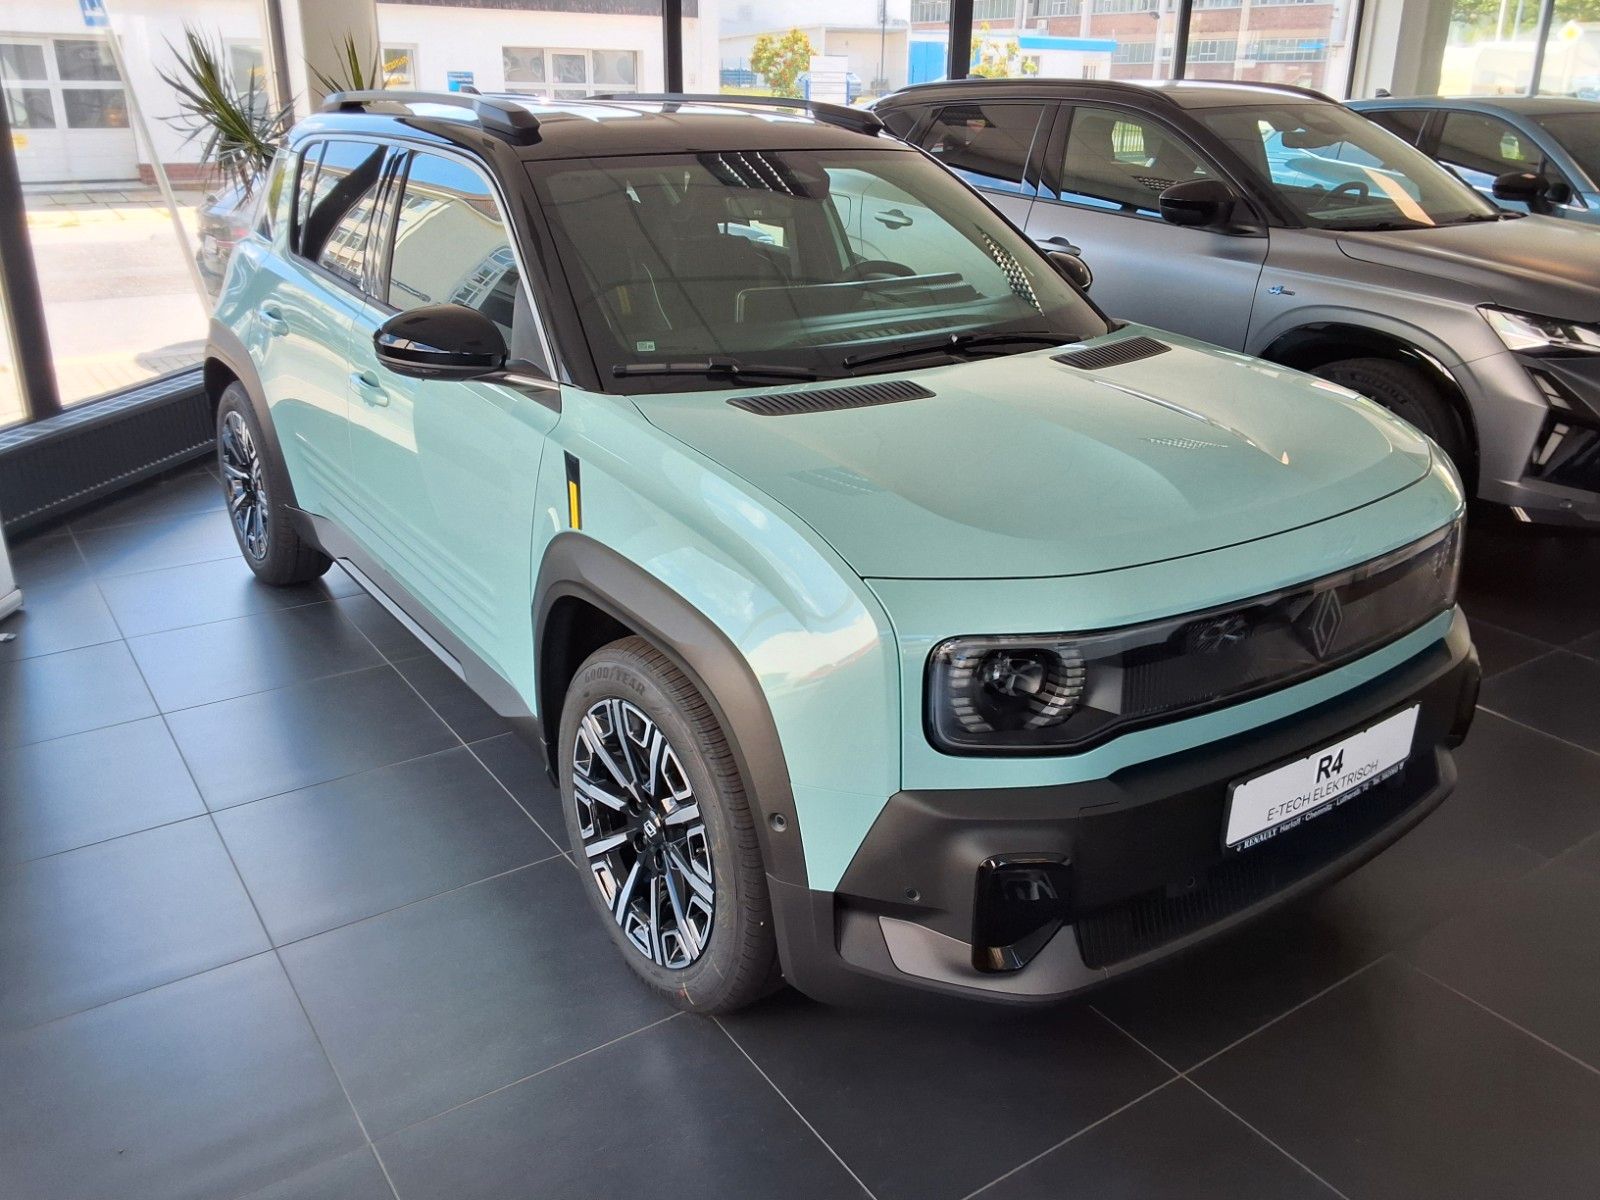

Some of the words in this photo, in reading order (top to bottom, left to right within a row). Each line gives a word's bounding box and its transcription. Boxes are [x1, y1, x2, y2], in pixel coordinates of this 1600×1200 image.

[1316, 748, 1344, 784] R4
[1267, 792, 1311, 821] E-TECH
[1313, 760, 1379, 801] ELEKTRISCH
[1243, 827, 1278, 849] RENAULT
